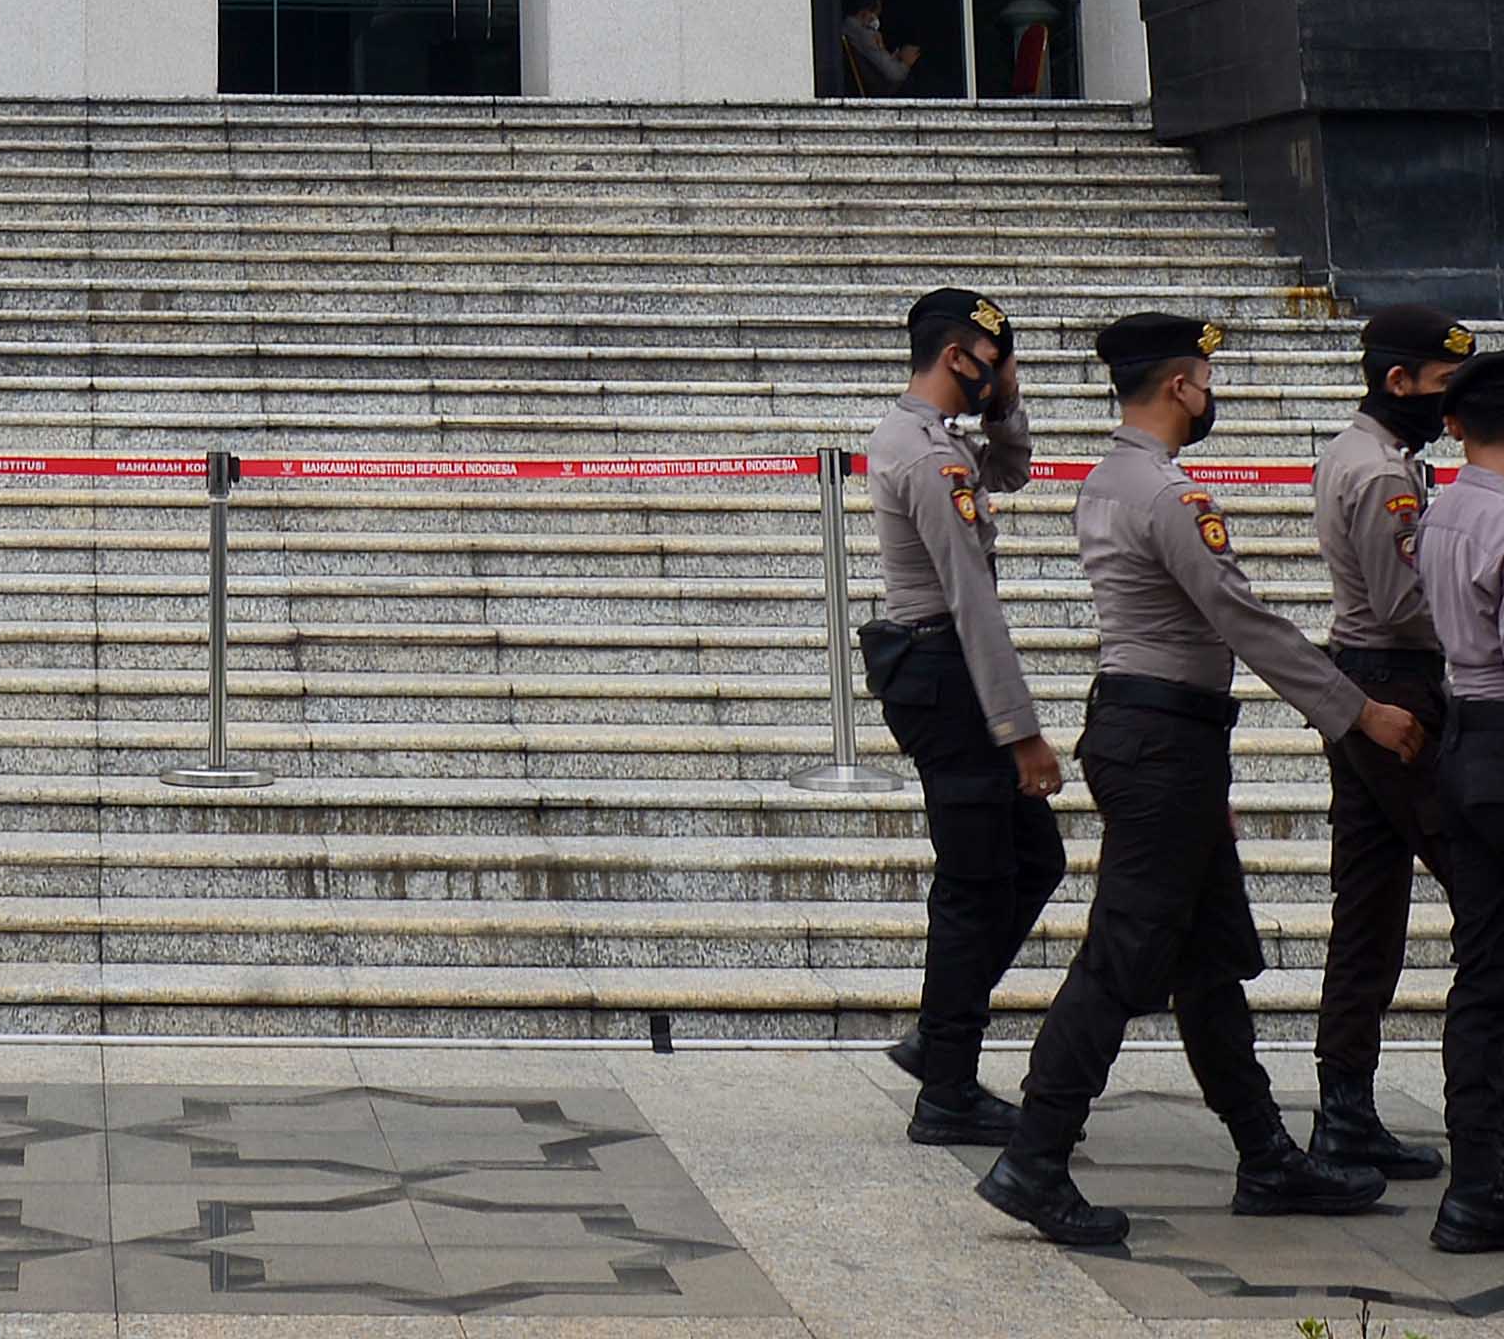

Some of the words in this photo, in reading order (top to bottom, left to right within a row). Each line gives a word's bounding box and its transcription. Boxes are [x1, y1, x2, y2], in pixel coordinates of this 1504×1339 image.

[116, 462, 182, 473] MAHKAMAH
[302, 462, 357, 475] MAHKAMAH
[359, 462, 416, 475] KONSTITUSI
[417, 463, 464, 475] REPUBLIK
[465, 463, 517, 475] INDONESIA
[582, 463, 638, 475] MAHKAMAH
[639, 462, 696, 475] KONSTITUSI
[697, 461, 744, 474] REPUBLIK
[745, 460, 798, 472] INDONESIA
[1192, 470, 1259, 480] KONSTITUSI
